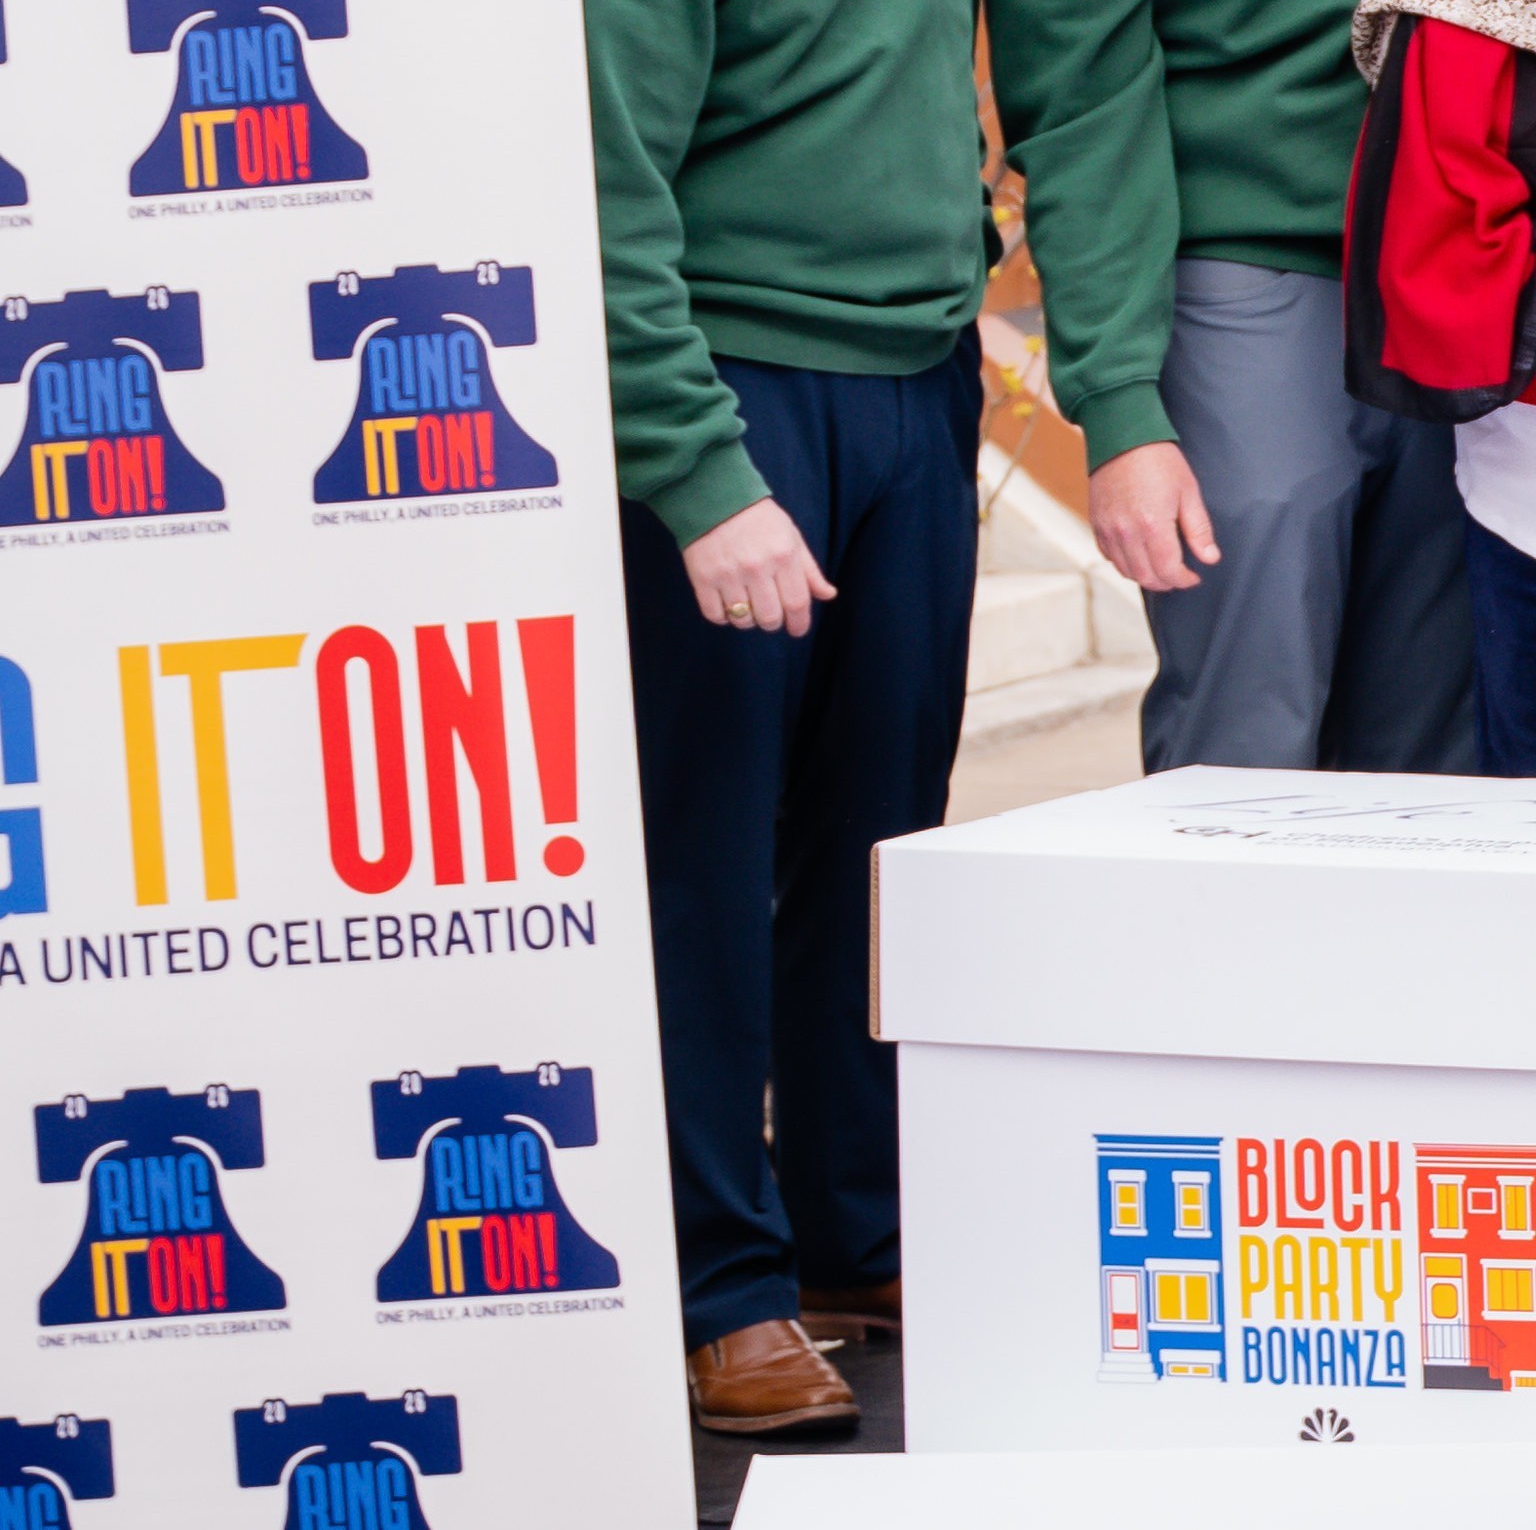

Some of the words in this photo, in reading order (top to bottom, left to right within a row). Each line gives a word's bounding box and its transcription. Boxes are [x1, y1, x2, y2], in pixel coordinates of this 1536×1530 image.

[185, 22, 298, 107] RING
[180, 109, 237, 189] IT
[235, 103, 311, 185] ON!
[36, 354, 152, 438] RING
[367, 330, 481, 413] RING
[30, 440, 88, 521] IT
[87, 435, 166, 516] ON!
[362, 417, 417, 496] IT
[416, 411, 496, 493] ON!
[117, 633, 309, 906] IT
[316, 614, 585, 894] ON!
[41, 927, 230, 984] UNITED
[247, 900, 597, 965] CELEBRATION
[95, 1152, 213, 1236] RING
[431, 1131, 544, 1212] RING
[1236, 1137, 1401, 1231] BLOCK
[90, 1238, 149, 1319] IT
[148, 1233, 227, 1314] ON!
[426, 1216, 482, 1295] IT
[481, 1212, 559, 1292] ON!
[1239, 1234, 1403, 1323] PARTY
[1242, 1326, 1406, 1389] BONANZA
[295, 1457, 411, 1530] RING
